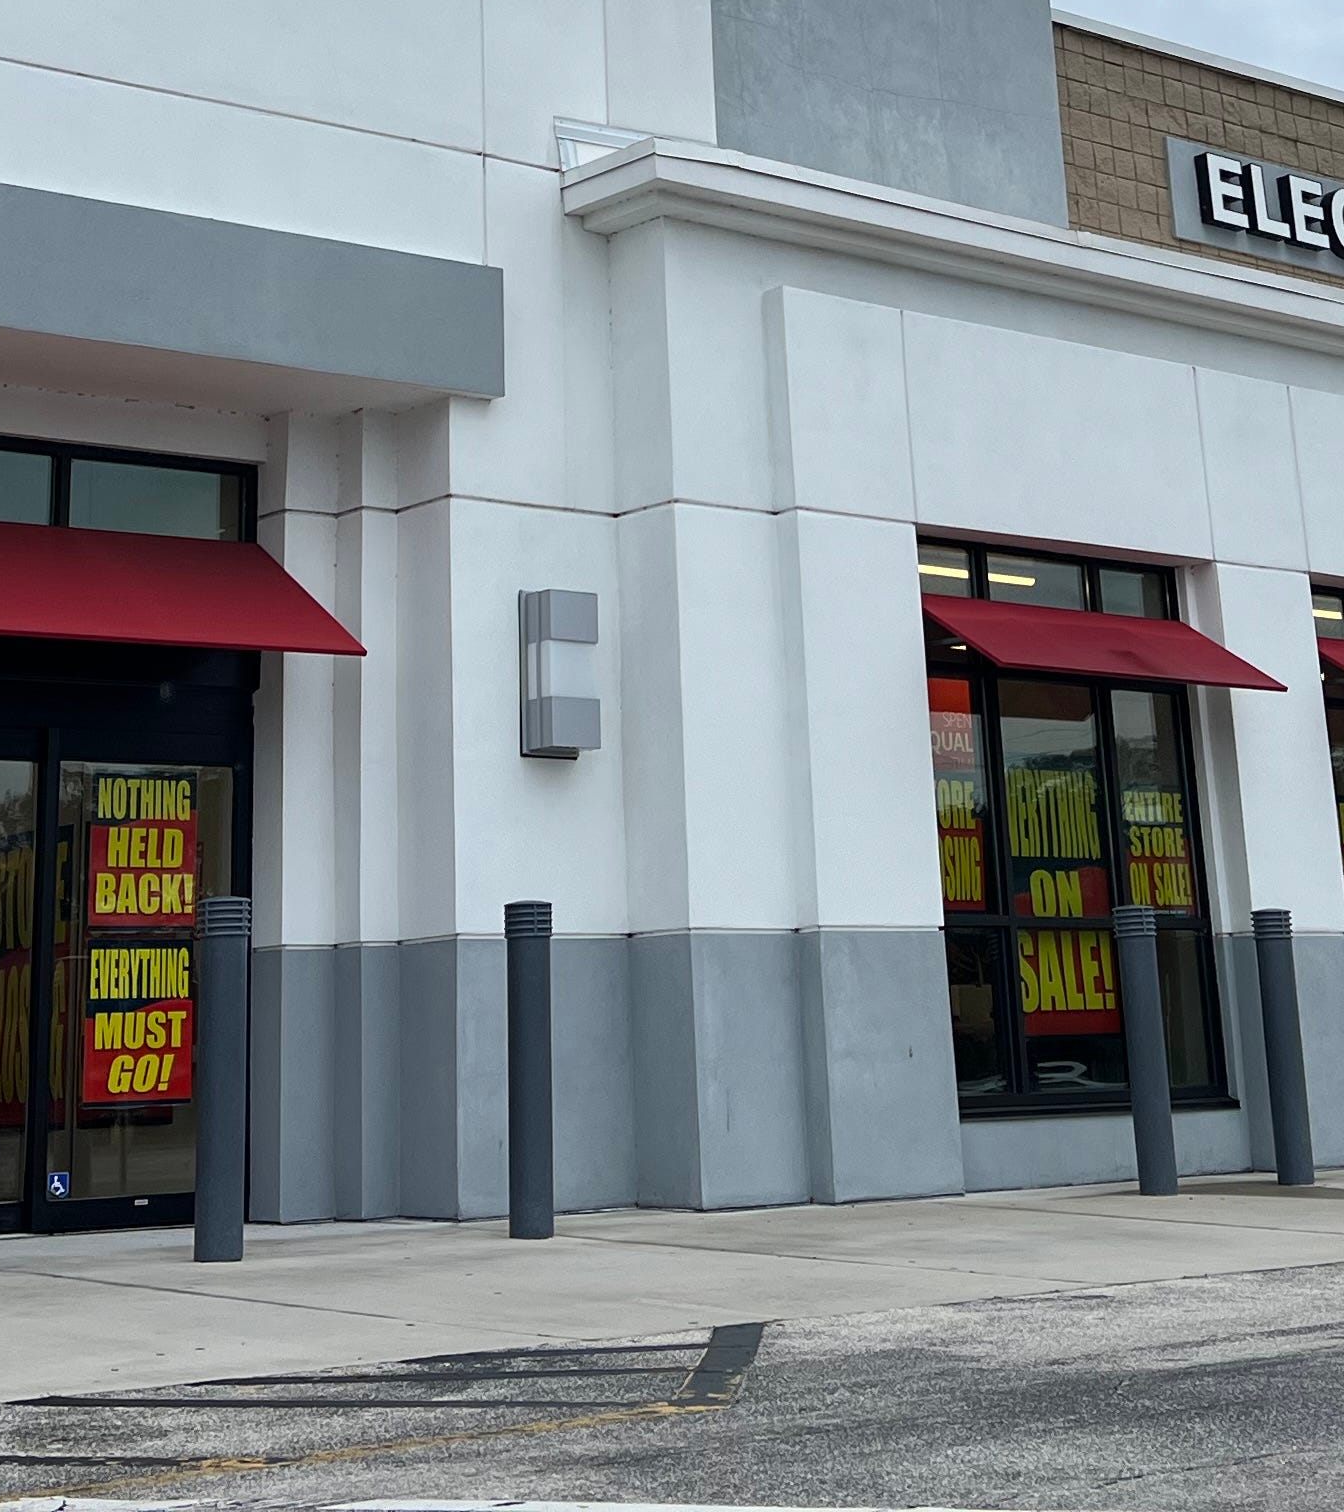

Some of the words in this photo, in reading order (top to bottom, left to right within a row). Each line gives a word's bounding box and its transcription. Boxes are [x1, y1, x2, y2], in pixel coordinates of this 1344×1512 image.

[97, 777, 191, 821] NOTHING
[936, 779, 976, 830] ORE
[1121, 790, 1183, 824] ENTIRE
[107, 827, 184, 868] HELD
[1129, 825, 1186, 858] STORE
[941, 836, 982, 902] SING
[1129, 862, 1151, 906] ON
[1153, 862, 1194, 907] SALE!
[95, 872, 194, 915] BACK!
[1030, 869, 1083, 918] ON
[89, 947, 189, 1000] EVERYTHING
[1017, 930, 1116, 1014] SALE!
[94, 1010, 187, 1050] MUST
[107, 1054, 175, 1094] GO!
